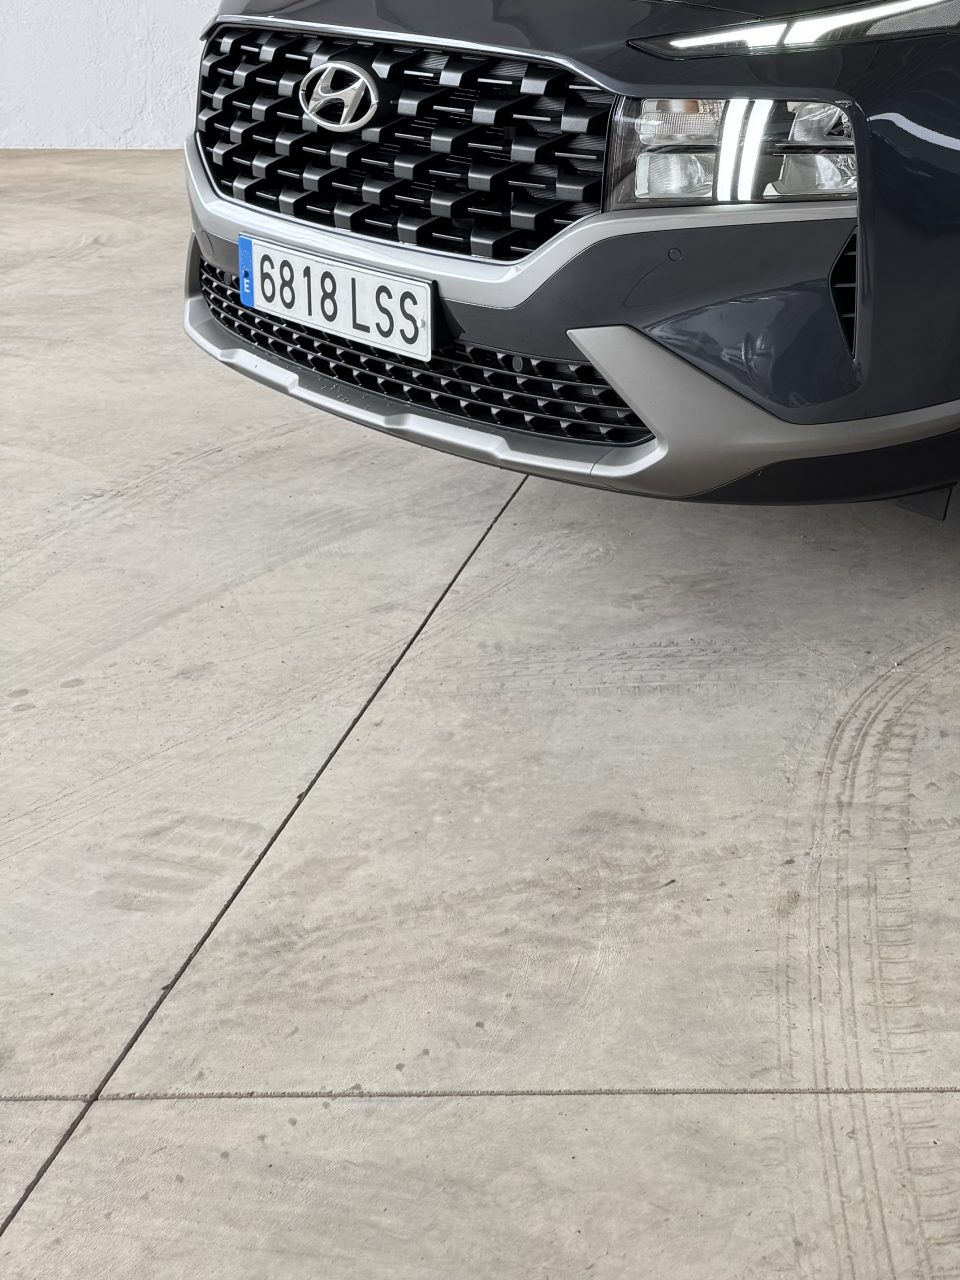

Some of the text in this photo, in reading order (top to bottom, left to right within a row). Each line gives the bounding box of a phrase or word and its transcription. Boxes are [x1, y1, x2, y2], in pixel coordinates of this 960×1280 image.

[243, 278, 250, 294] E
[259, 253, 420, 346] 6818 LSS
